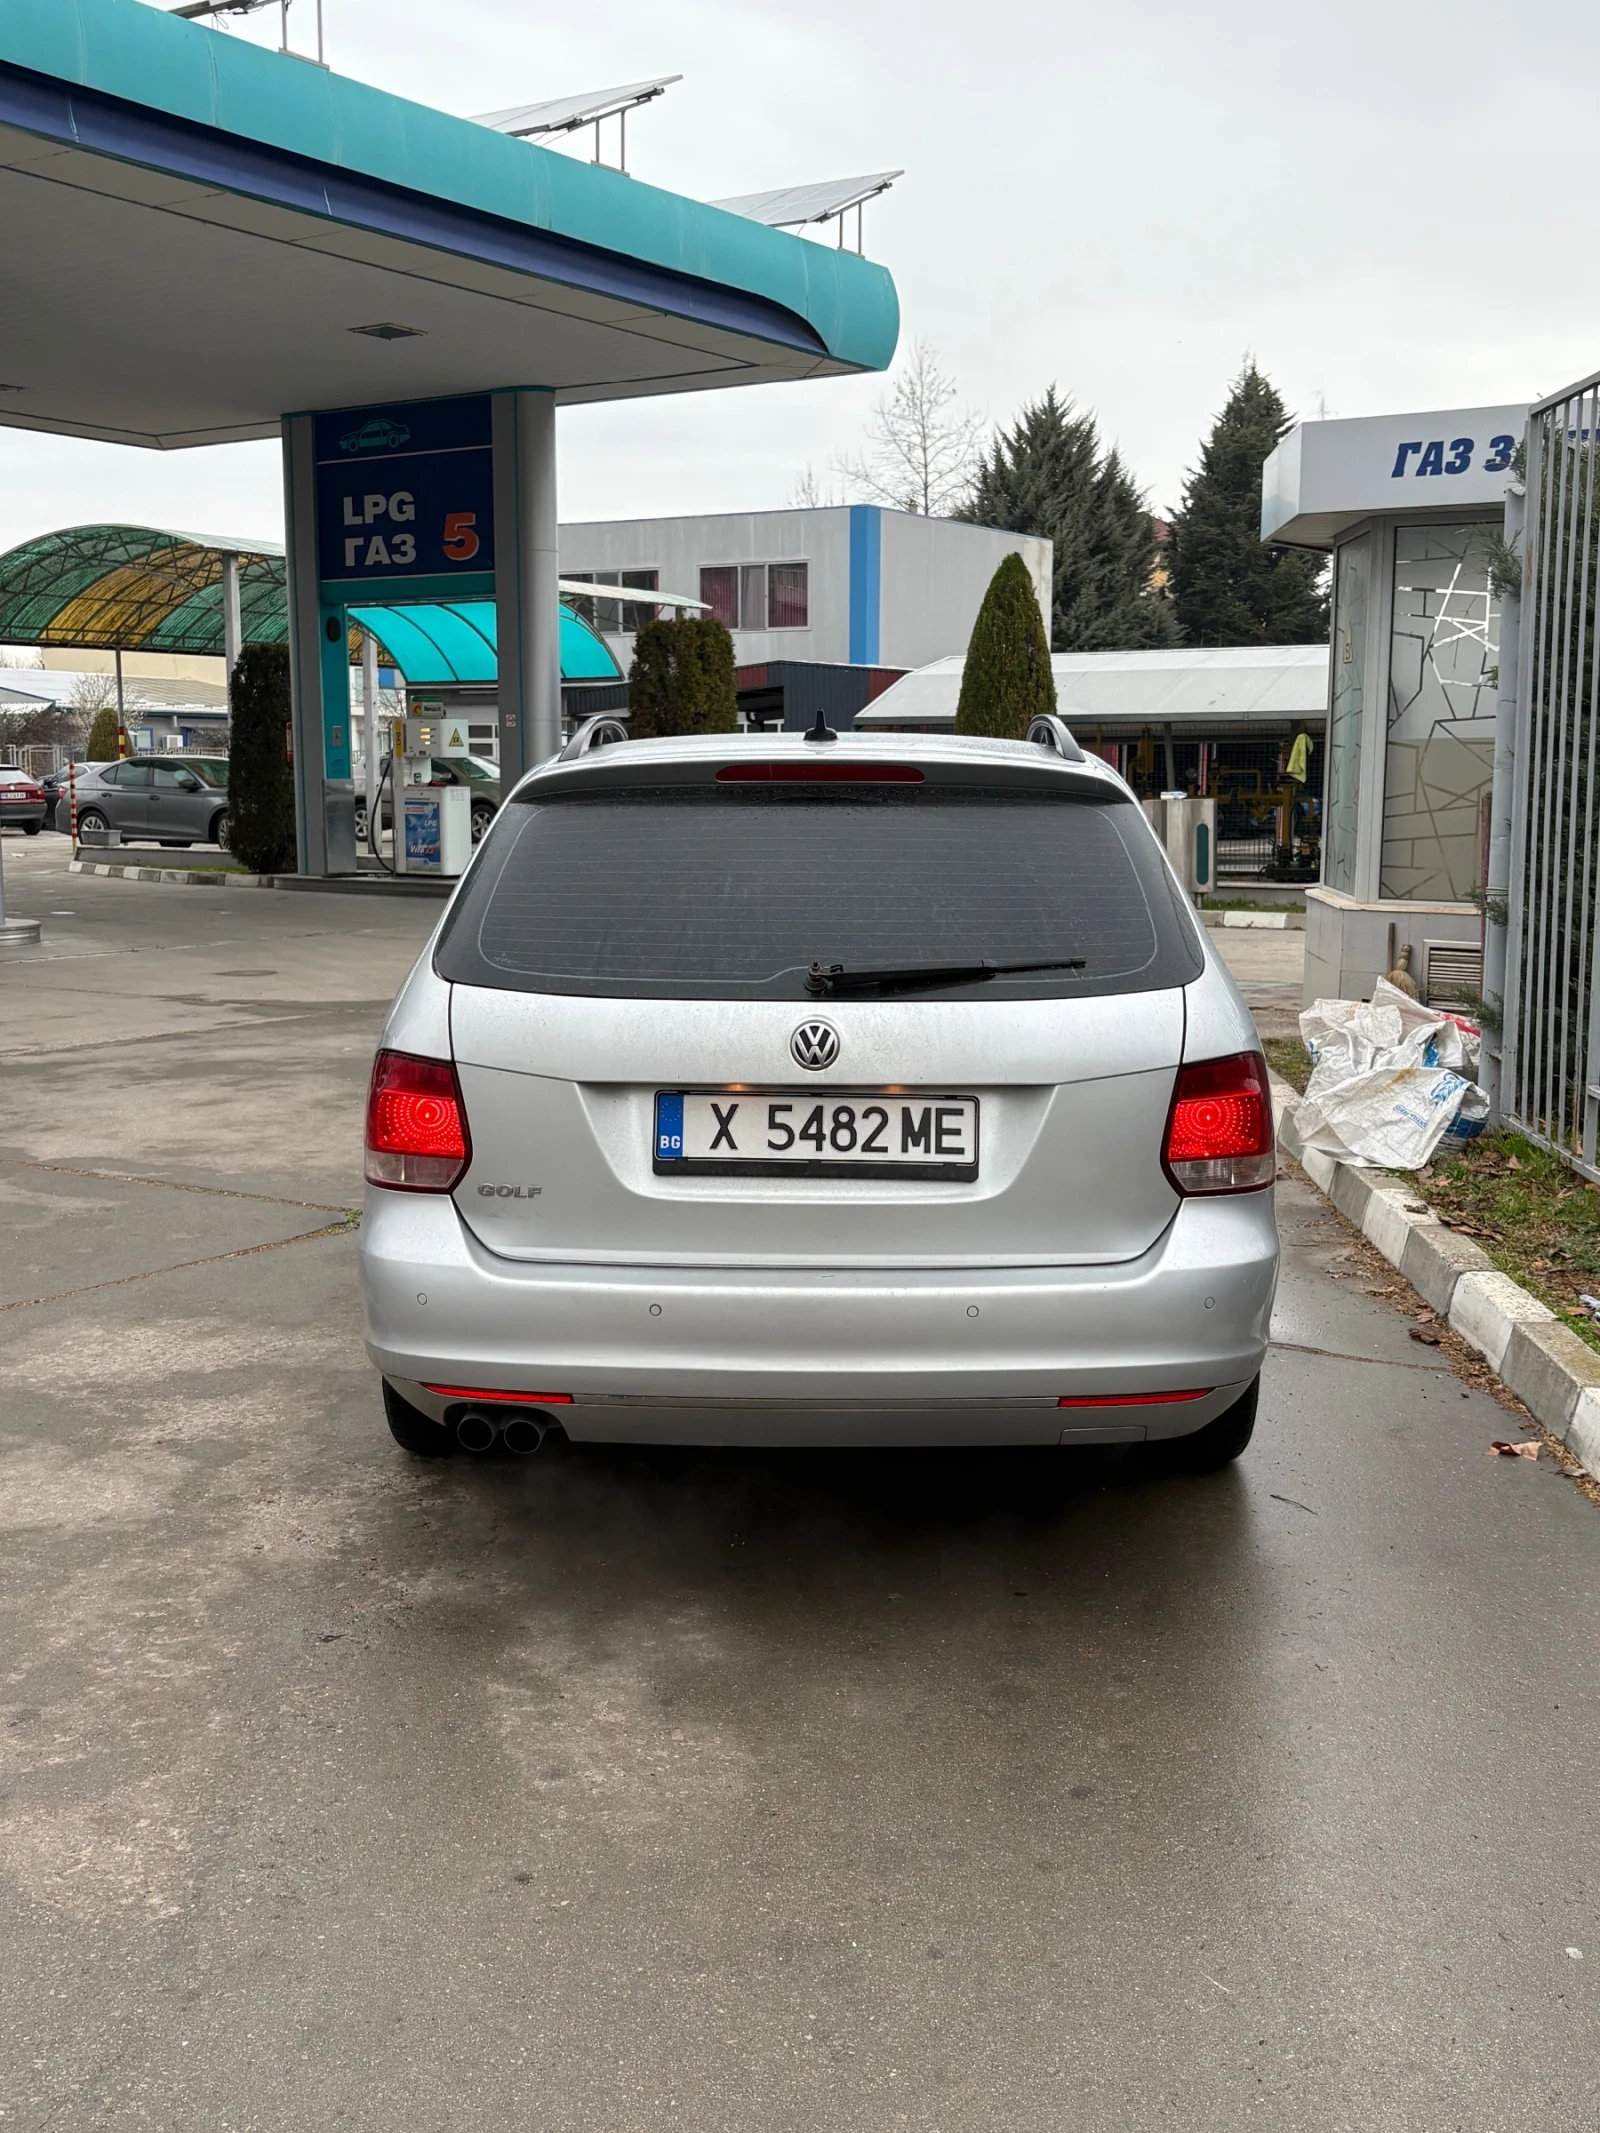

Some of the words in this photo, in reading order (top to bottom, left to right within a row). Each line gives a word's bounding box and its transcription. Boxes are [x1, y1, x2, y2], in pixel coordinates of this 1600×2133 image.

[1391, 437, 1474, 478] ГАЗ
[343, 491, 416, 526] LPG
[344, 533, 417, 567] ГАЗ
[442, 511, 480, 561] 5
[424, 819, 437, 827] LPG
[660, 1135, 681, 1150] BG
[709, 1103, 739, 1150] X
[767, 1104, 889, 1153] 5482
[901, 1106, 965, 1155] ME
[477, 1182, 543, 1199] GOLF
